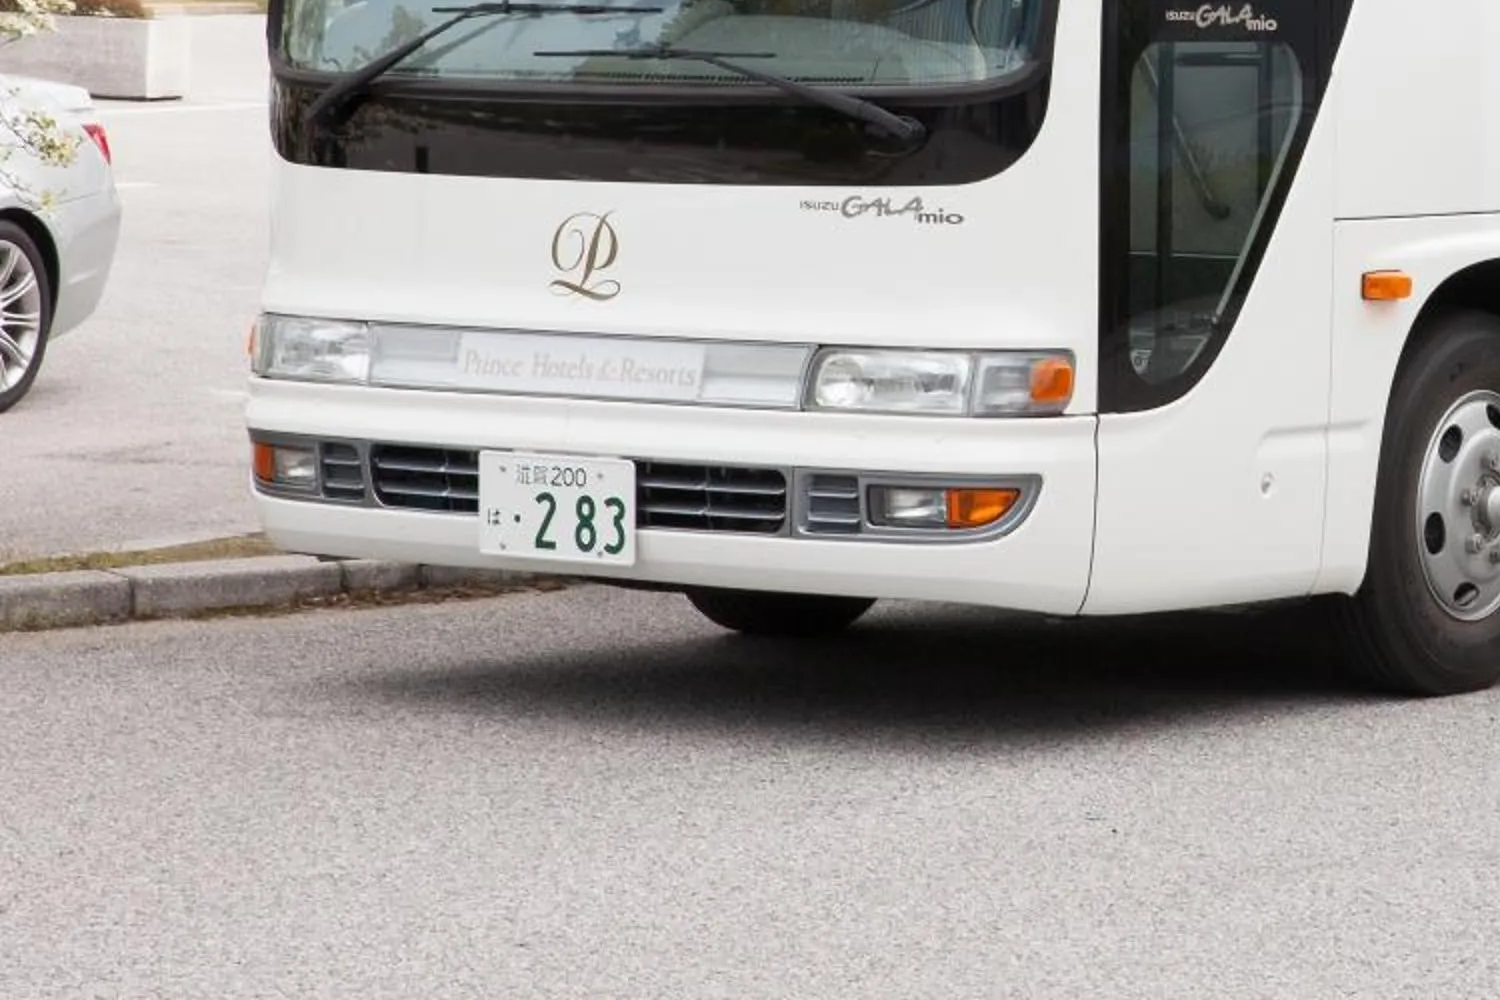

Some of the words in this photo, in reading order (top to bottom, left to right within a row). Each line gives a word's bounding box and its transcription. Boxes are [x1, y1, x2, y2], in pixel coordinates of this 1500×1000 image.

[1165, 10, 1195, 21] ISUZU
[1195, 3, 1253, 28] GALA
[1246, 15, 1278, 31] mio
[799, 200, 840, 211] ISUZU
[841, 195, 924, 218] GALA
[915, 207, 965, 224] mio
[464, 350, 521, 377] Prince
[532, 352, 594, 380] Hotels
[618, 356, 697, 387] Resorts
